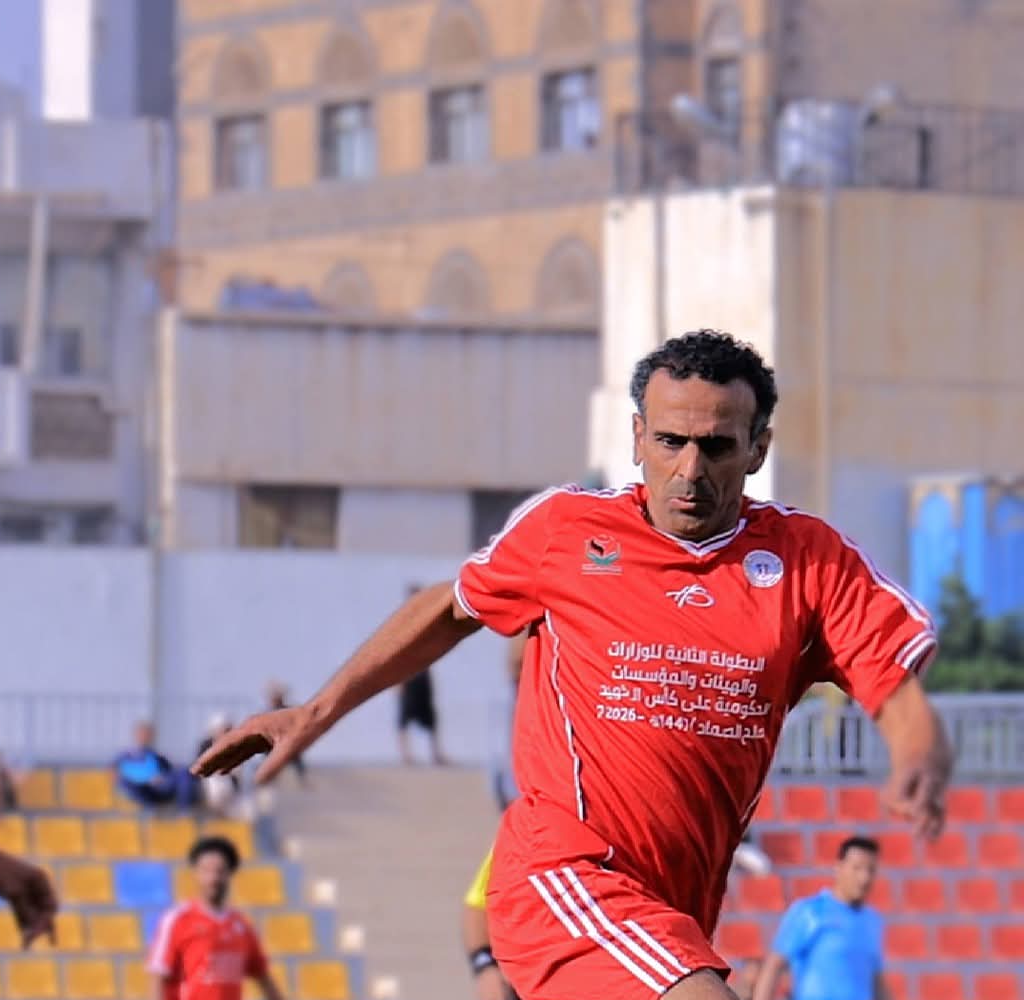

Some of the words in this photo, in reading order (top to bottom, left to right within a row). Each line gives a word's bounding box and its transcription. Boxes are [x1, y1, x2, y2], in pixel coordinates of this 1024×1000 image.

[607, 641, 663, 662] للوزارات
[665, 645, 707, 666] الثانية
[710, 650, 765, 673] البطولة
[611, 664, 697, 690] والمؤسسات
[700, 673, 757, 698] والهيئات
[644, 686, 679, 708] كأس
[680, 695, 711, 712] على
